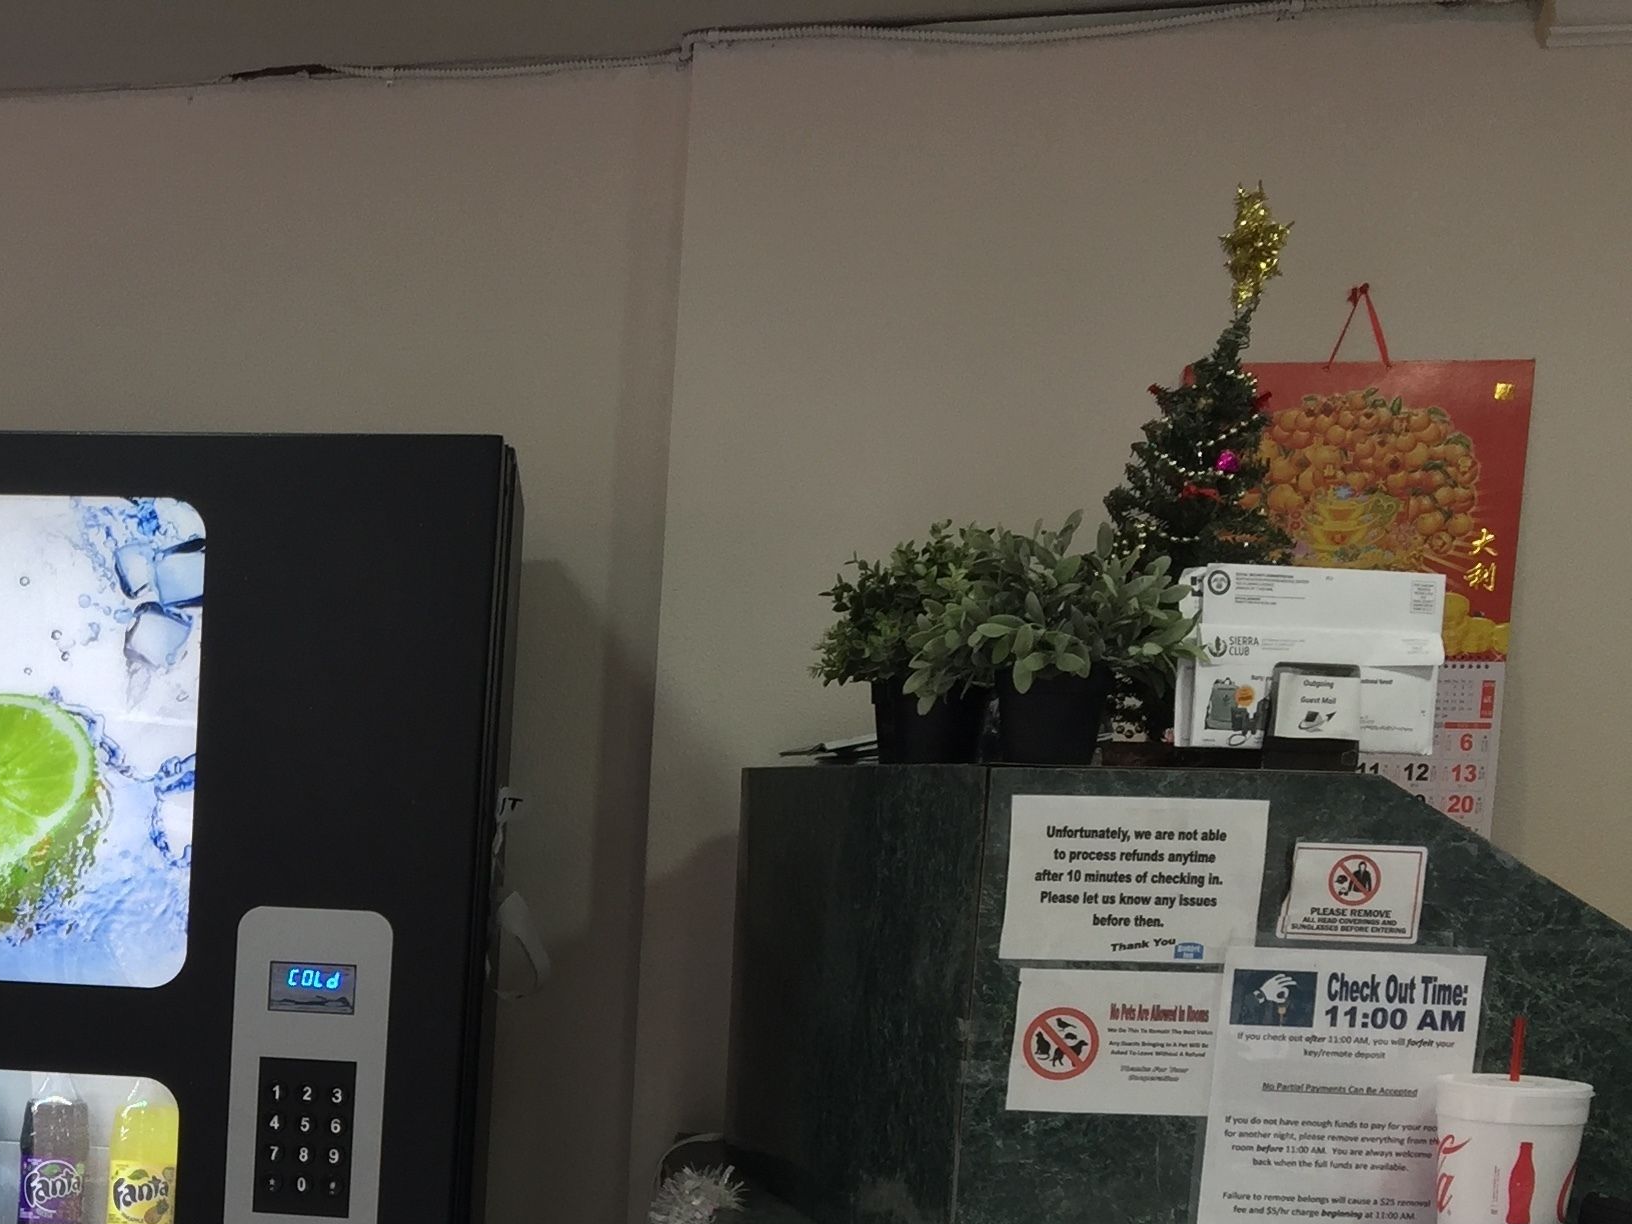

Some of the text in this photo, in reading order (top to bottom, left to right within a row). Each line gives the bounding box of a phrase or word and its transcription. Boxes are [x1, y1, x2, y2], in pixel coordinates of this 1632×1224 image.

[1229, 636, 1259, 646] SIERRA
[1229, 647, 1250, 656] CLUB
[1303, 680, 1334, 689] Outgoing
[1300, 696, 1336, 704] Guest Mail
[1460, 734, 1473, 751] 6
[1404, 763, 1429, 781] 12
[1452, 764, 1477, 782] 13
[1447, 795, 1474, 813] 20
[1046, 825, 1227, 842] Unfortunately, we are not able
[1054, 850, 1216, 865] to process refunds anytime
[1035, 870, 1223, 887] after 10 minutes of checking in.
[1040, 892, 1217, 908] Please let us know any issues
[1093, 914, 1164, 927] before then.
[1311, 907, 1392, 918] PLEASE REMOVE
[1110, 938, 1176, 952] Thank You
[1327, 972, 1468, 1006] Check Out Time:
[1110, 1003, 1209, 1022] No Pets Are Allowed In Rooms
[1325, 1005, 1466, 1032] 11:00 AM
[1237, 1032, 1243, 1040] If
[1246, 1034, 1261, 1042] you
[1263, 1033, 1286, 1042] check
[1289, 1034, 1303, 1042] out
[1305, 1035, 1326, 1044] after
[1328, 1035, 1352, 1044] 11:00
[1353, 1037, 1370, 1046] AM,
[1373, 1038, 1389, 1046] you
[1391, 1038, 1405, 1046] will
[1406, 1038, 1434, 1048] forfeit
[1303, 1049, 1385, 1059] key/remote deposit
[272, 1085, 342, 1103] 1 2 3
[1262, 1082, 1274, 1090] No
[1276, 1082, 1304, 1092] Partial
[1306, 1083, 1346, 1094] Payments
[1348, 1085, 1363, 1094] Can
[1379, 1087, 1418, 1097] Accepted
[269, 1114, 341, 1133] 4 5 6
[270, 1146, 339, 1164] 7 8 9
[25, 1169, 82, 1207] Fanta
[113, 1176, 168, 1209] Fanta
[297, 1177, 306, 1192] 0
[1223, 1192, 1251, 1200] Failure
[1264, 1194, 1296, 1202] remove
[1297, 1194, 1329, 1204] belongs
[1331, 1196, 1346, 1204] will
[1348, 1197, 1371, 1205] cause
[1380, 1198, 1395, 1206] $25
[1397, 1199, 1431, 1207] removal
